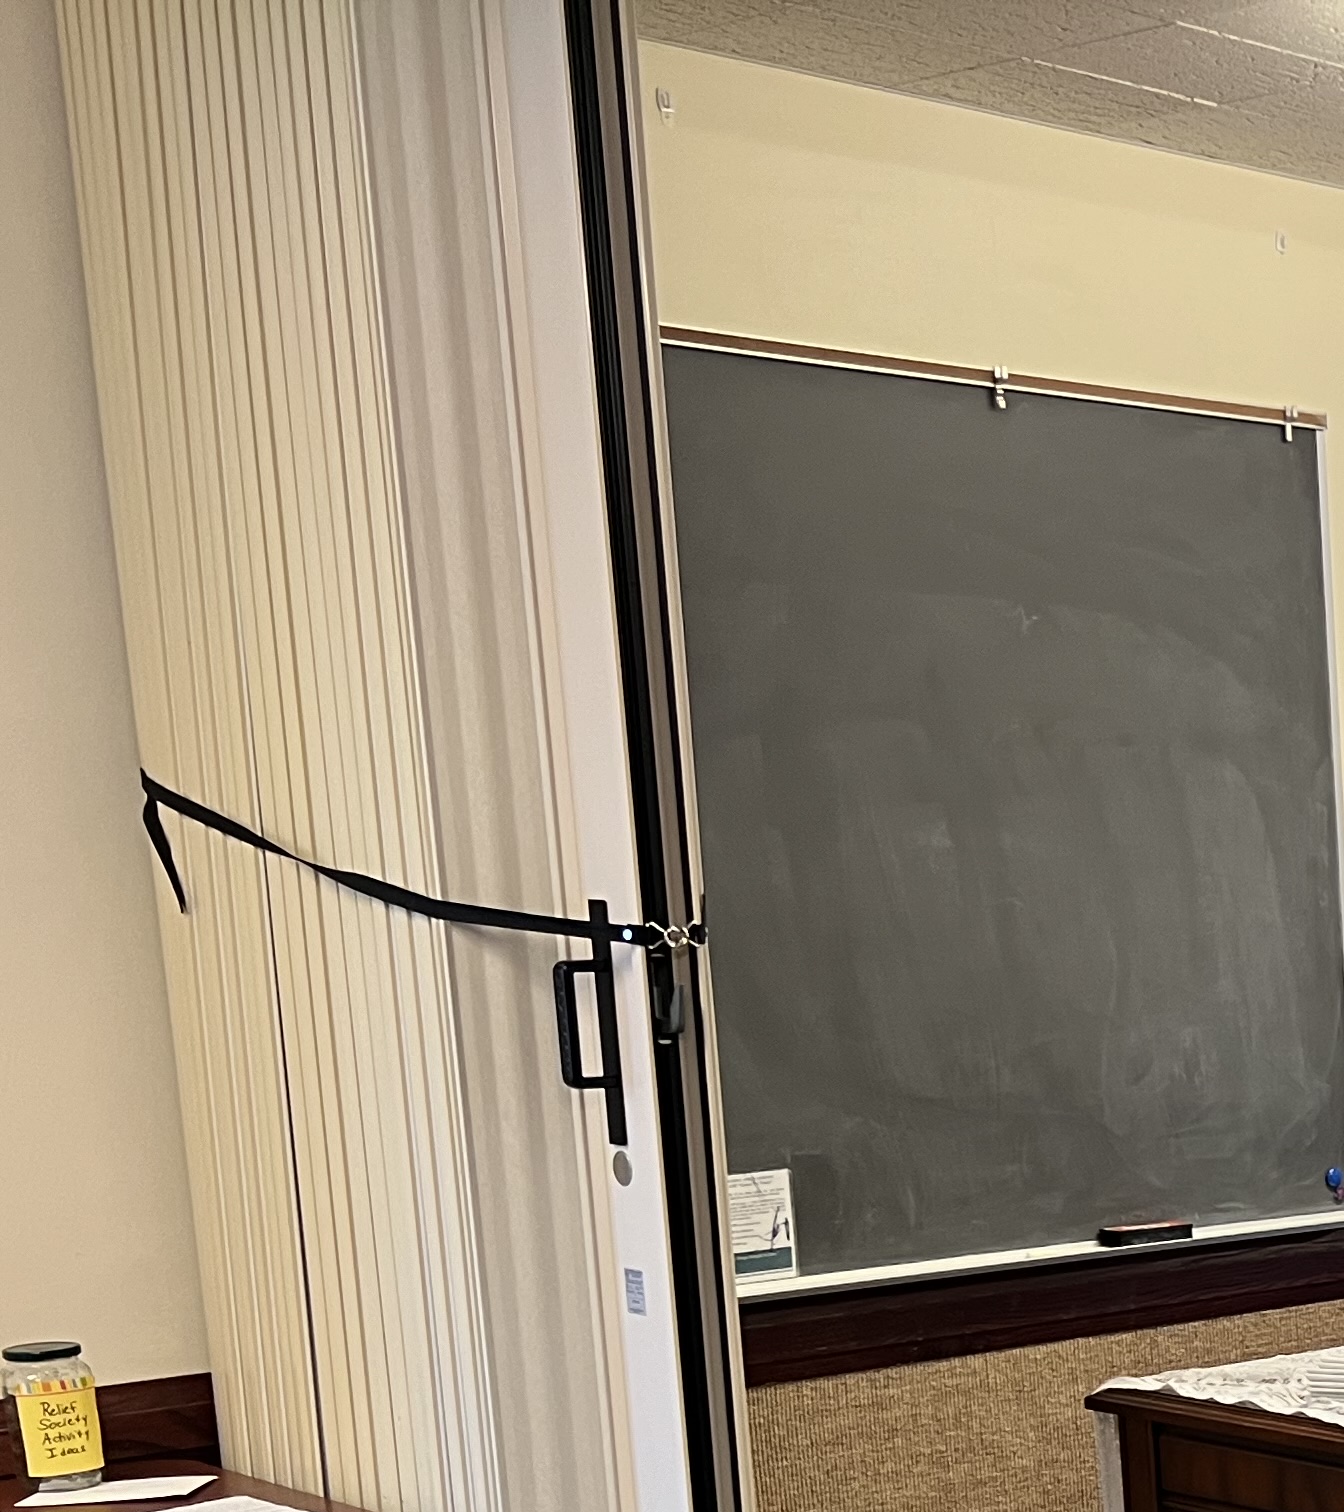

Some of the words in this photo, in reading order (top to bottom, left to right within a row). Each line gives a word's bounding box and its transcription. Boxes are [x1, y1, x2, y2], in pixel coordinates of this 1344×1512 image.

[39, 1401, 77, 1417] Relief
[37, 1414, 88, 1431] Society
[42, 1430, 89, 1446] Activity
[45, 1445, 86, 1459] Ideas
